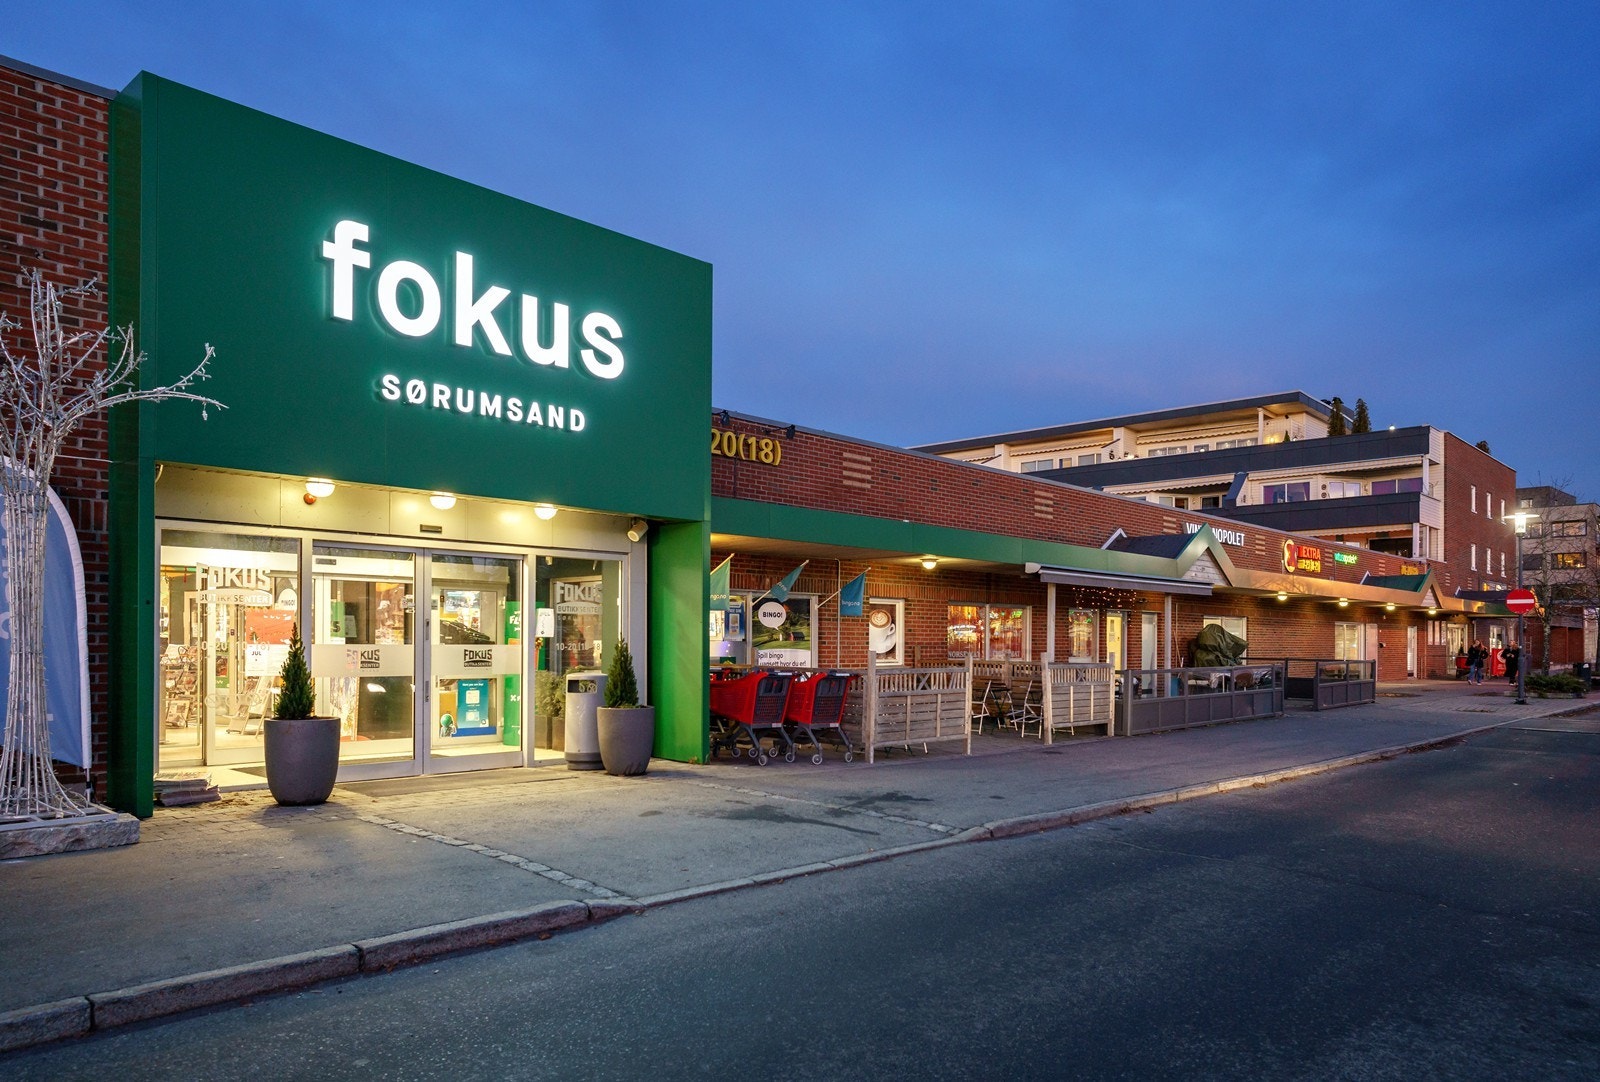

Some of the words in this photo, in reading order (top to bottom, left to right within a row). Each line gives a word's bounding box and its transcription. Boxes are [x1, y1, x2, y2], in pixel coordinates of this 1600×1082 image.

[322, 219, 625, 379] fokus
[381, 374, 586, 432] SØRUMSAND
[1186, 522, 1245, 547] VINNOPOLET
[1302, 546, 1321, 560] EXTRA
[196, 562, 271, 591] FOKUS
[556, 581, 602, 605] FOKUS
[464, 649, 492, 660] FOKUS
[769, 652, 784, 660] bingo
